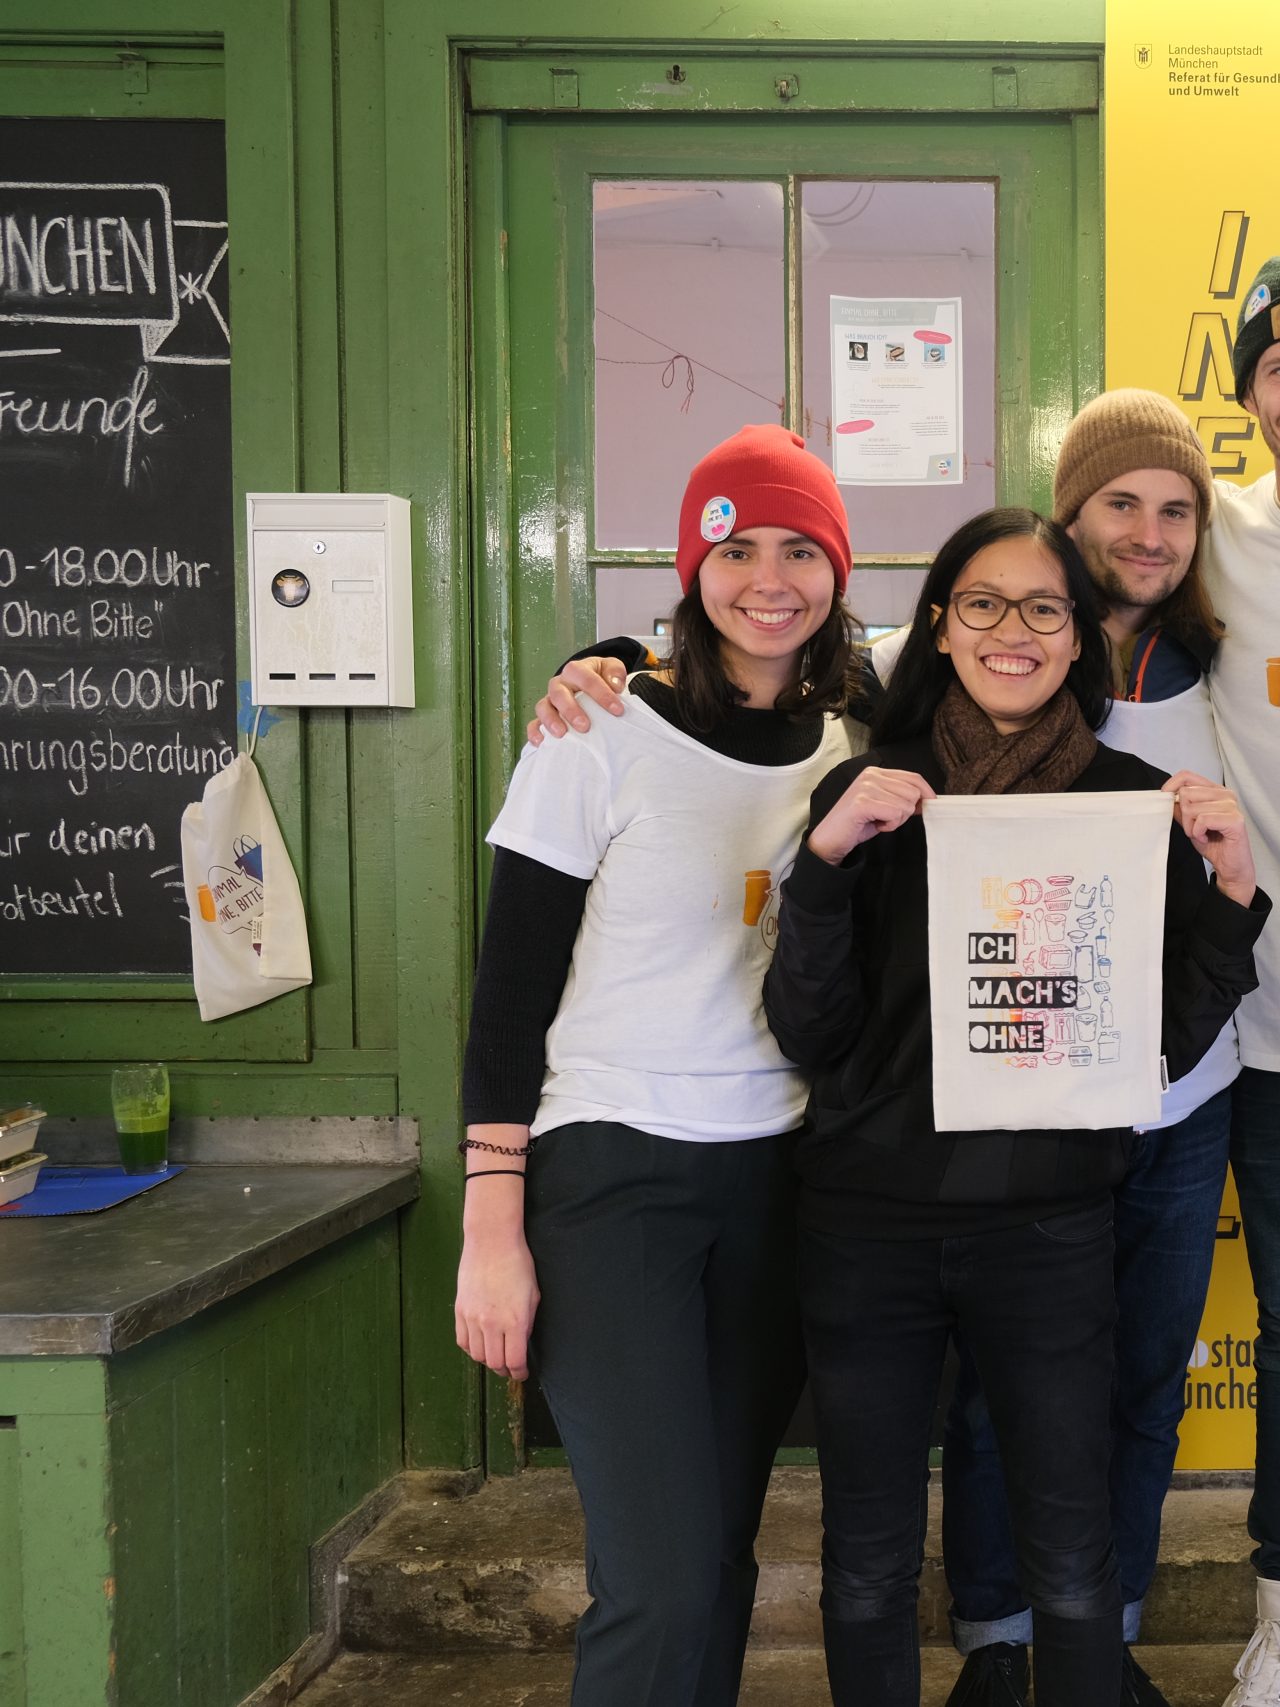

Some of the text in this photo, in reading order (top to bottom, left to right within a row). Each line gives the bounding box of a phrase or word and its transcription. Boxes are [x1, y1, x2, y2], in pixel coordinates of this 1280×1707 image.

[1168, 44, 1263, 58] Landeshauptstadt
[1168, 58, 1219, 69] München
[1168, 72, 1210, 83] Referat
[1214, 72, 1230, 83] für
[1168, 86, 1239, 97] und Umwelt
[0, 214, 156, 296] NCHEN
[152, 547, 211, 588] Uhr
[3, 600, 81, 637] Ohne
[166, 666, 225, 711] Uhr
[49, 818, 155, 857] deinen
[236, 886, 264, 912] BITTE
[969, 936, 1014, 961] ICH
[969, 979, 1077, 1006] MACH'S
[969, 1024, 1044, 1049] OHNE
